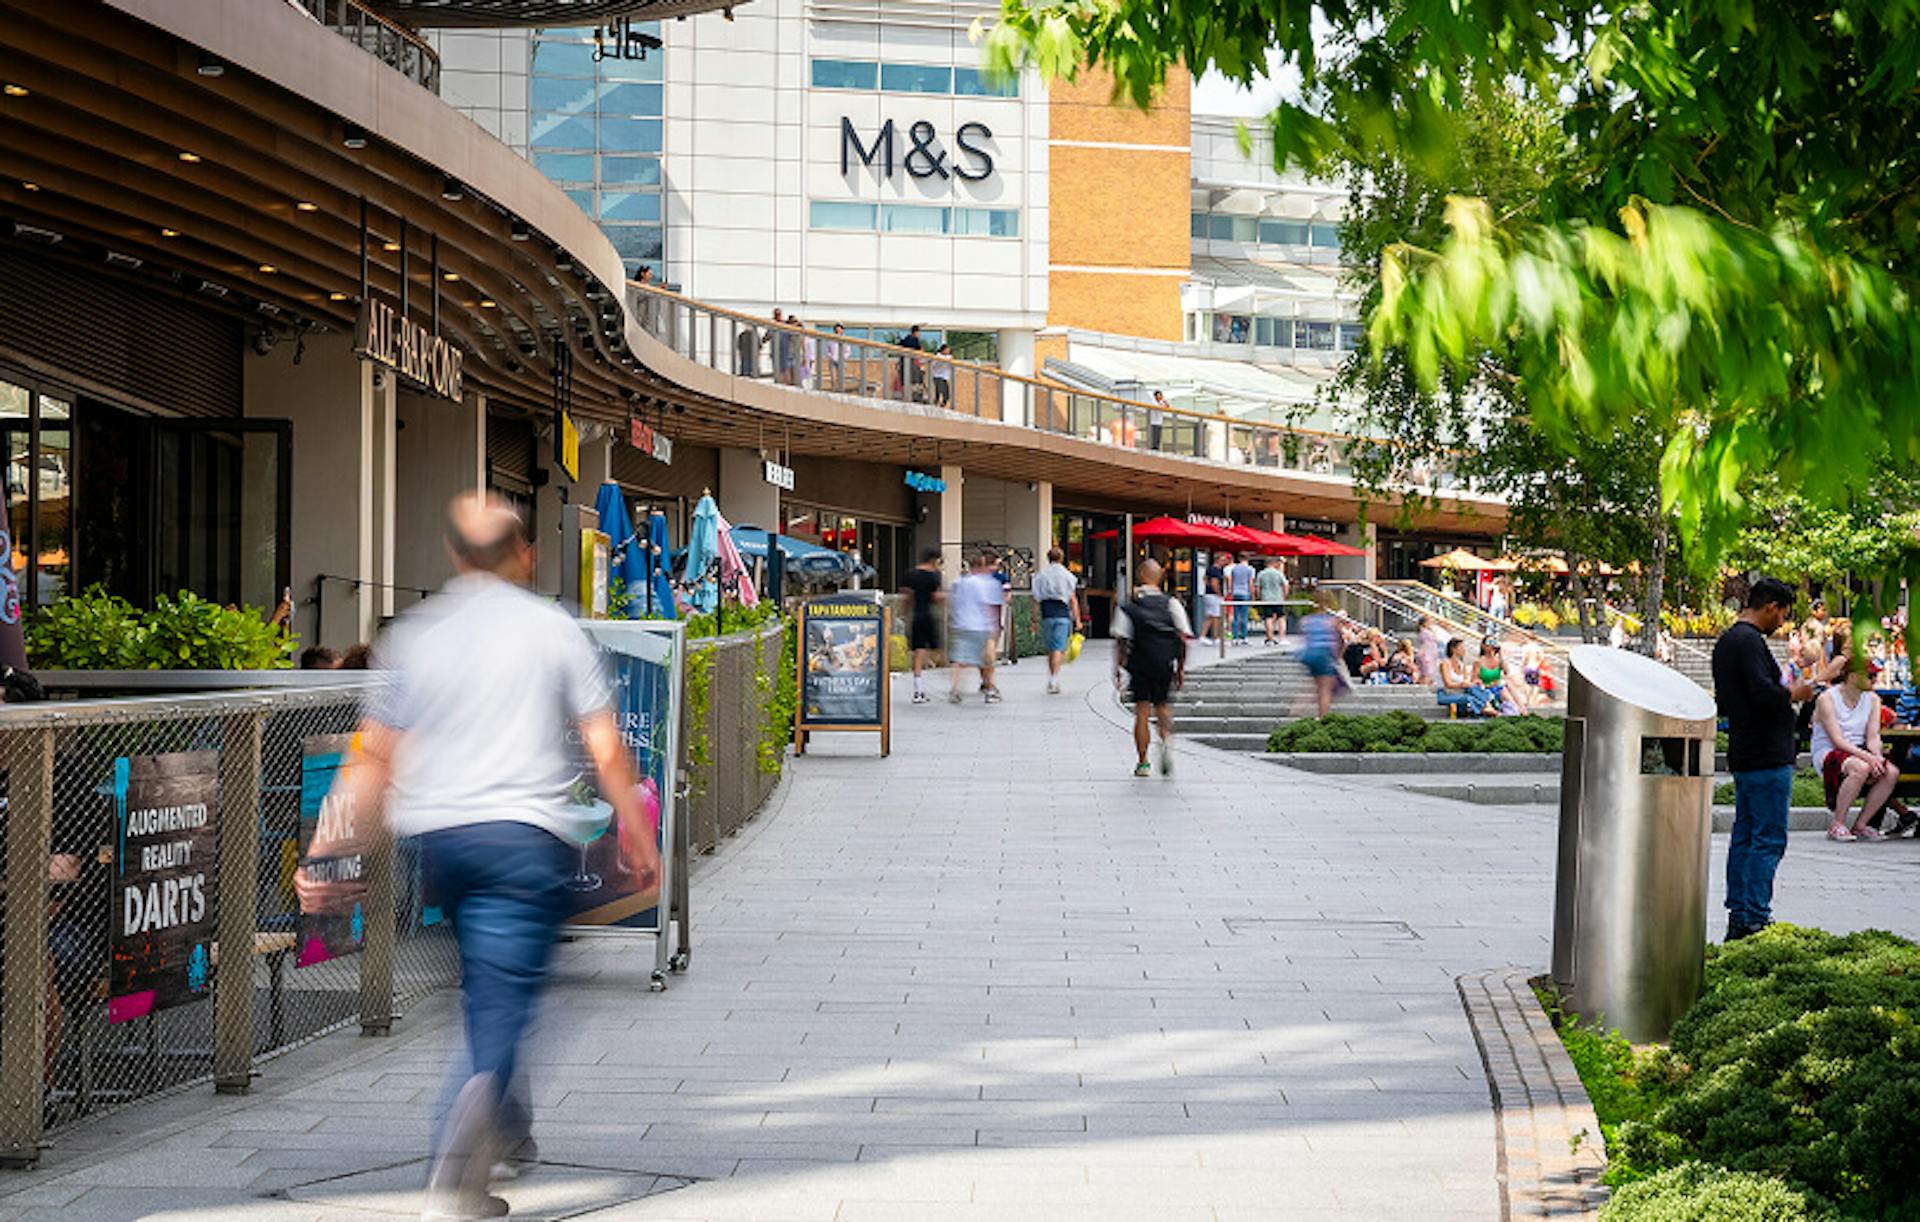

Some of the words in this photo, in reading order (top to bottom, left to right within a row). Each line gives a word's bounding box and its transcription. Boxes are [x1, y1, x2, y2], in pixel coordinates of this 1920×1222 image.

[841, 116, 993, 180] M&S
[127, 803, 208, 837] AUGMENTED
[316, 792, 356, 845] AXE
[141, 840, 193, 872] REALITY
[124, 872, 206, 937] DARTS
